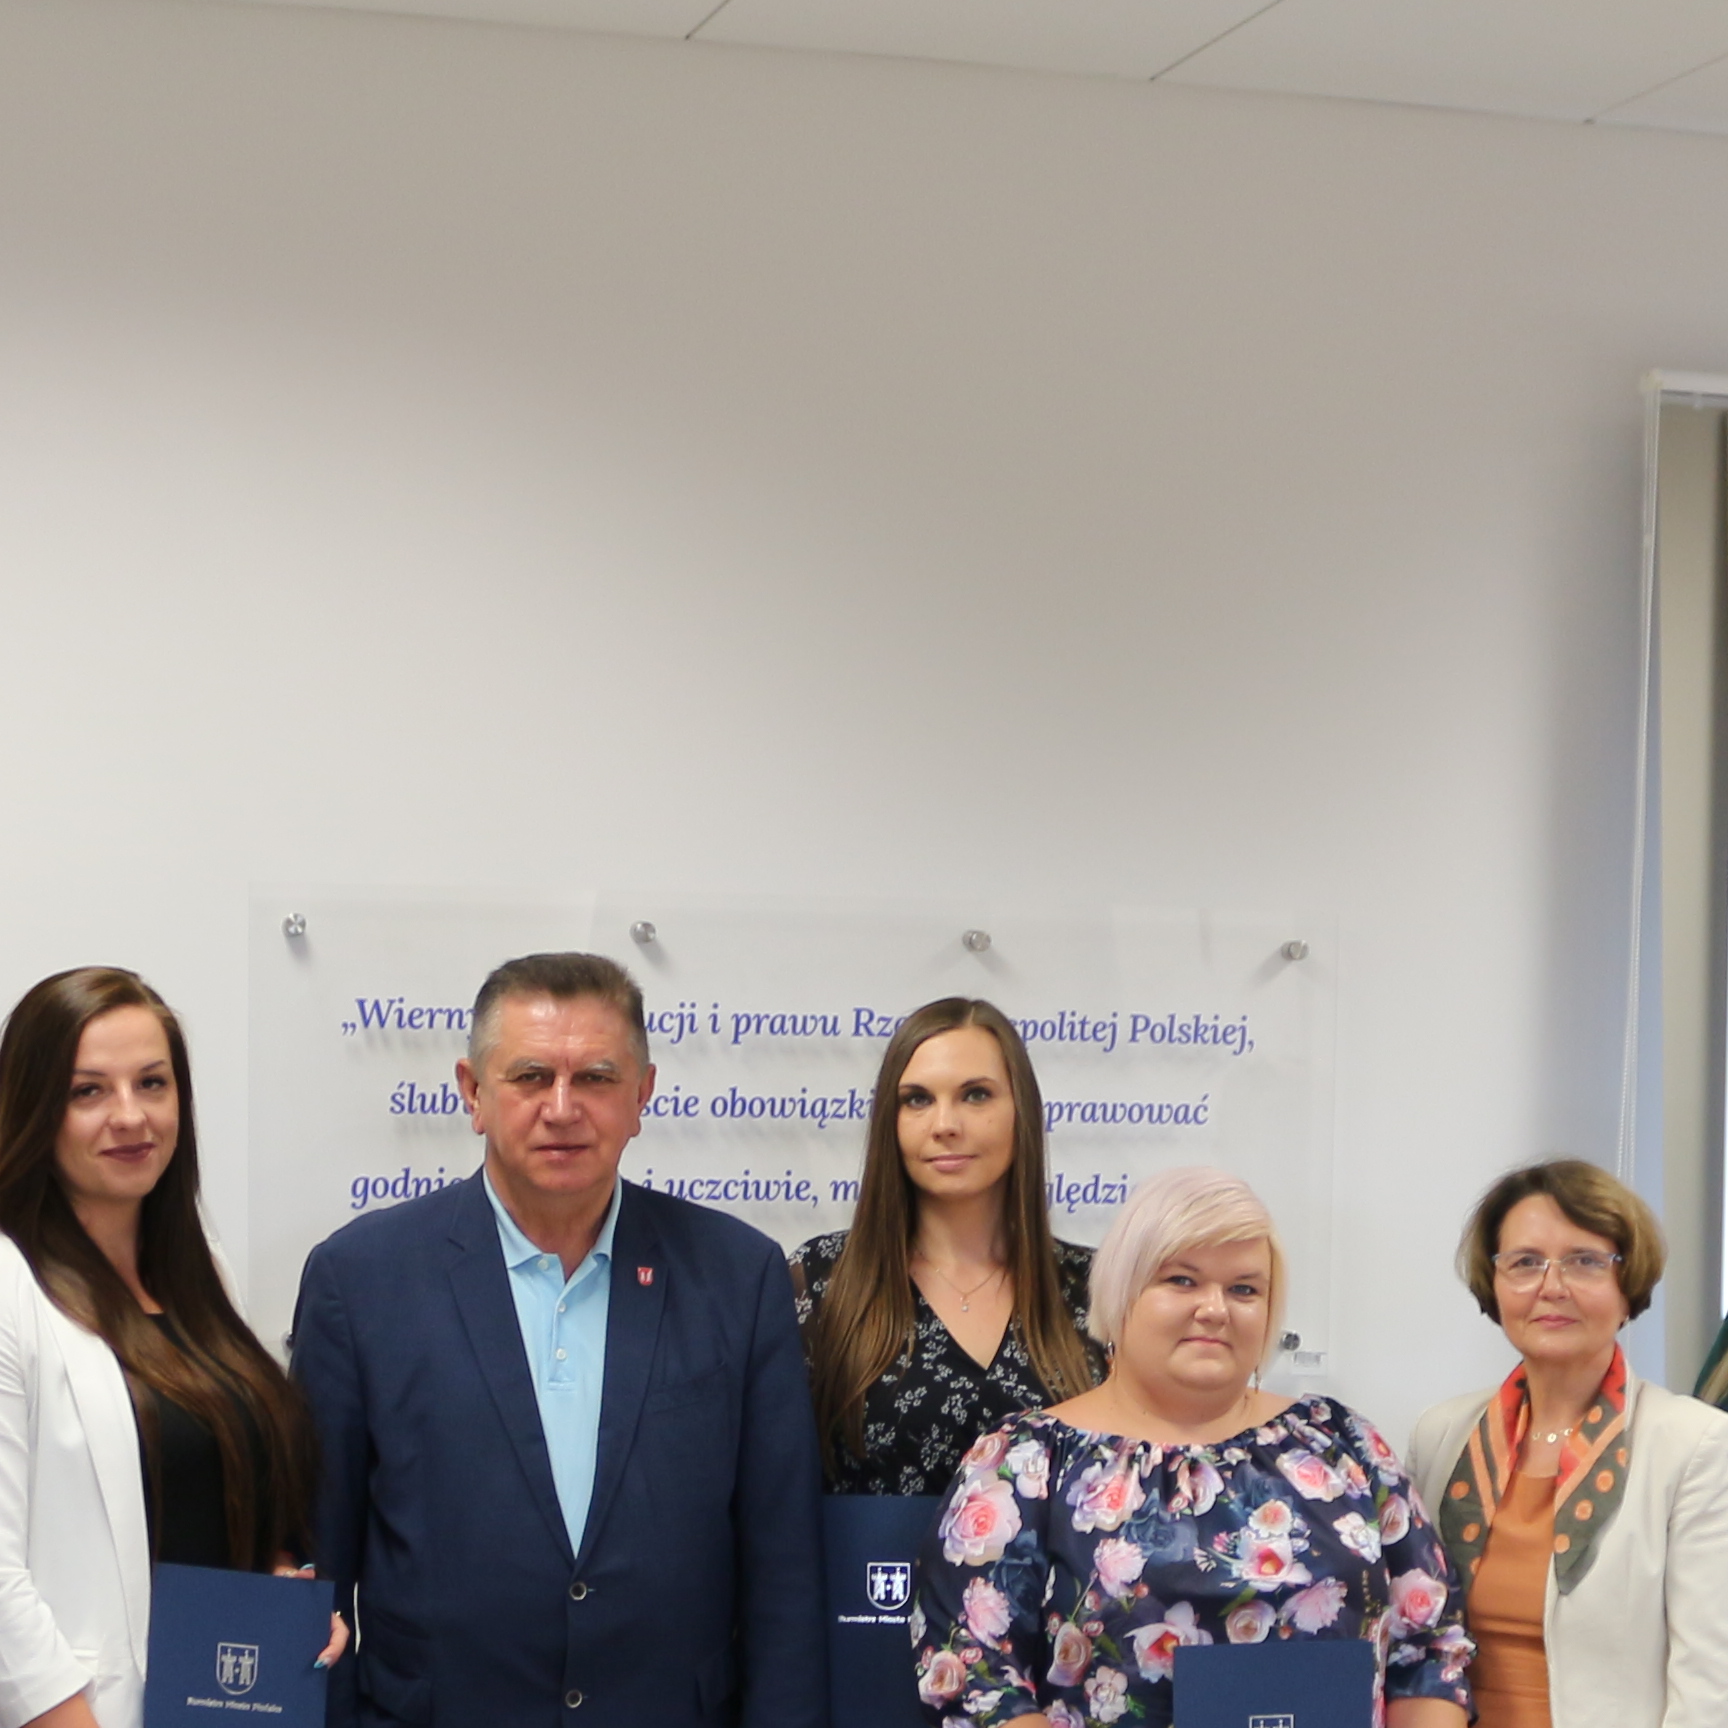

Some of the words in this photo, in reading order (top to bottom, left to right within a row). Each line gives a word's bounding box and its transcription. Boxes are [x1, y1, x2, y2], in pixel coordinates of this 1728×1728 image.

[710, 1002, 721, 1034] i
[731, 1010, 841, 1044] prawu
[1129, 1013, 1255, 1056] Polskiej,
[1043, 1094, 1210, 1132] prawować
[666, 1169, 819, 1207] uczciwie,
